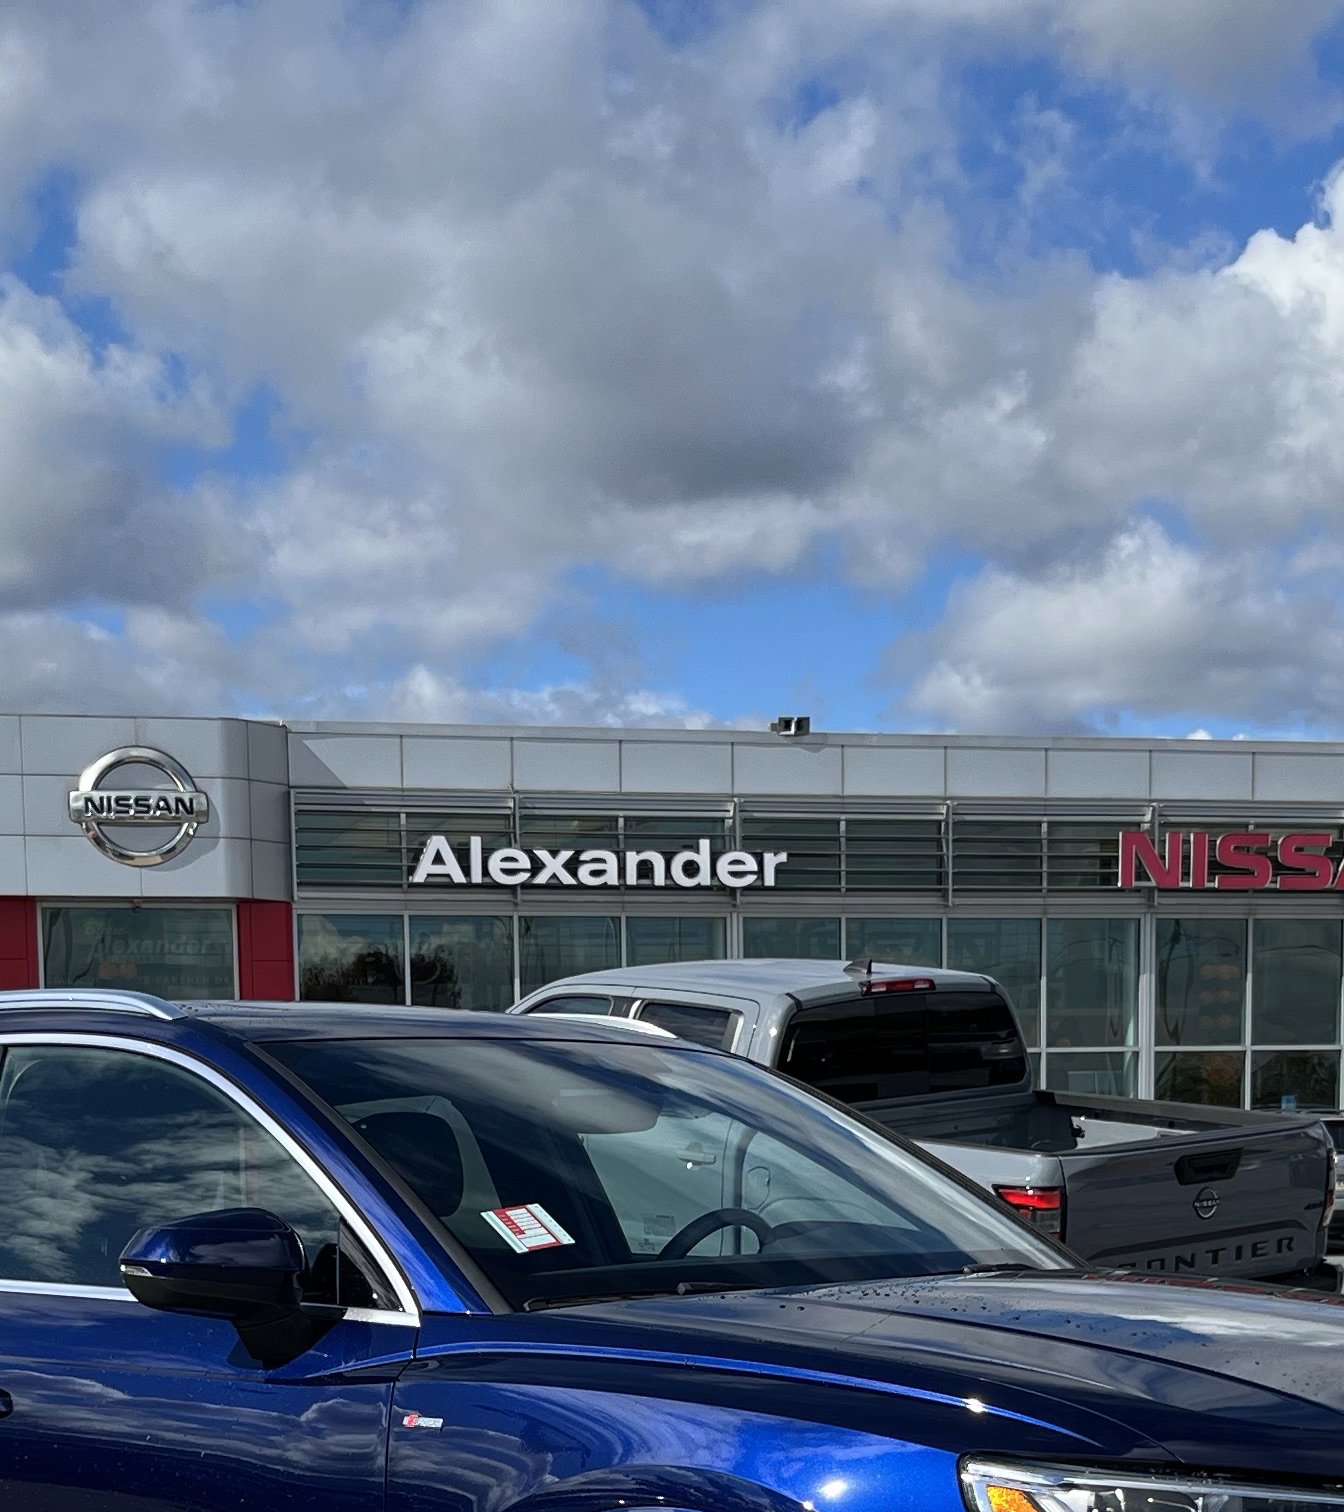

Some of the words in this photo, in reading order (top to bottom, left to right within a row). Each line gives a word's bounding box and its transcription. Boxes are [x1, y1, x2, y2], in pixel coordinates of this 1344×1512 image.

[84, 795, 195, 816] NISSAN
[410, 835, 788, 887] Alexander
[1118, 1236, 1294, 1271] ONTIER
